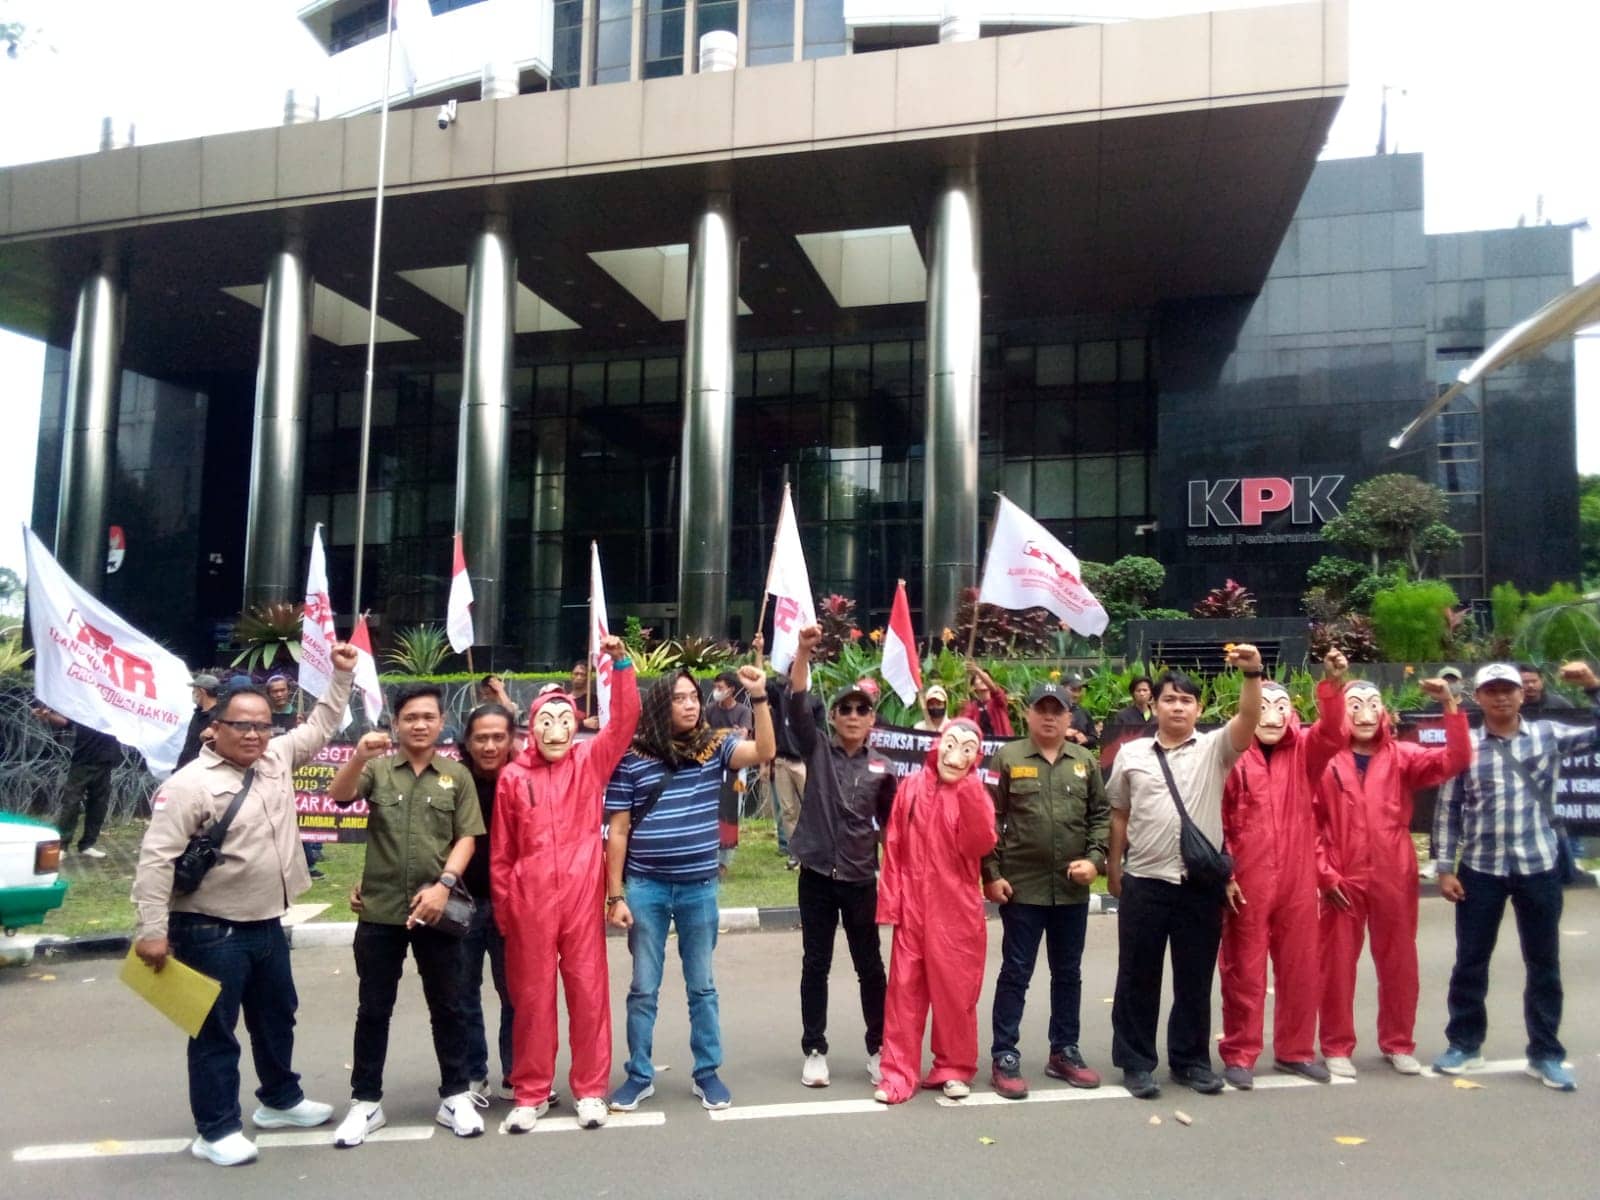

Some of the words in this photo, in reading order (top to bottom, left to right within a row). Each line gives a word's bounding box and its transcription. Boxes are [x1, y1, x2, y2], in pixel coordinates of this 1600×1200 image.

[1188, 475, 1345, 528] KPK
[1187, 534, 1233, 546] Komisi
[869, 732, 914, 751] PERIKSA
[313, 746, 357, 761] GGI
[294, 766, 337, 778] GOTA
[292, 779, 318, 791] 019
